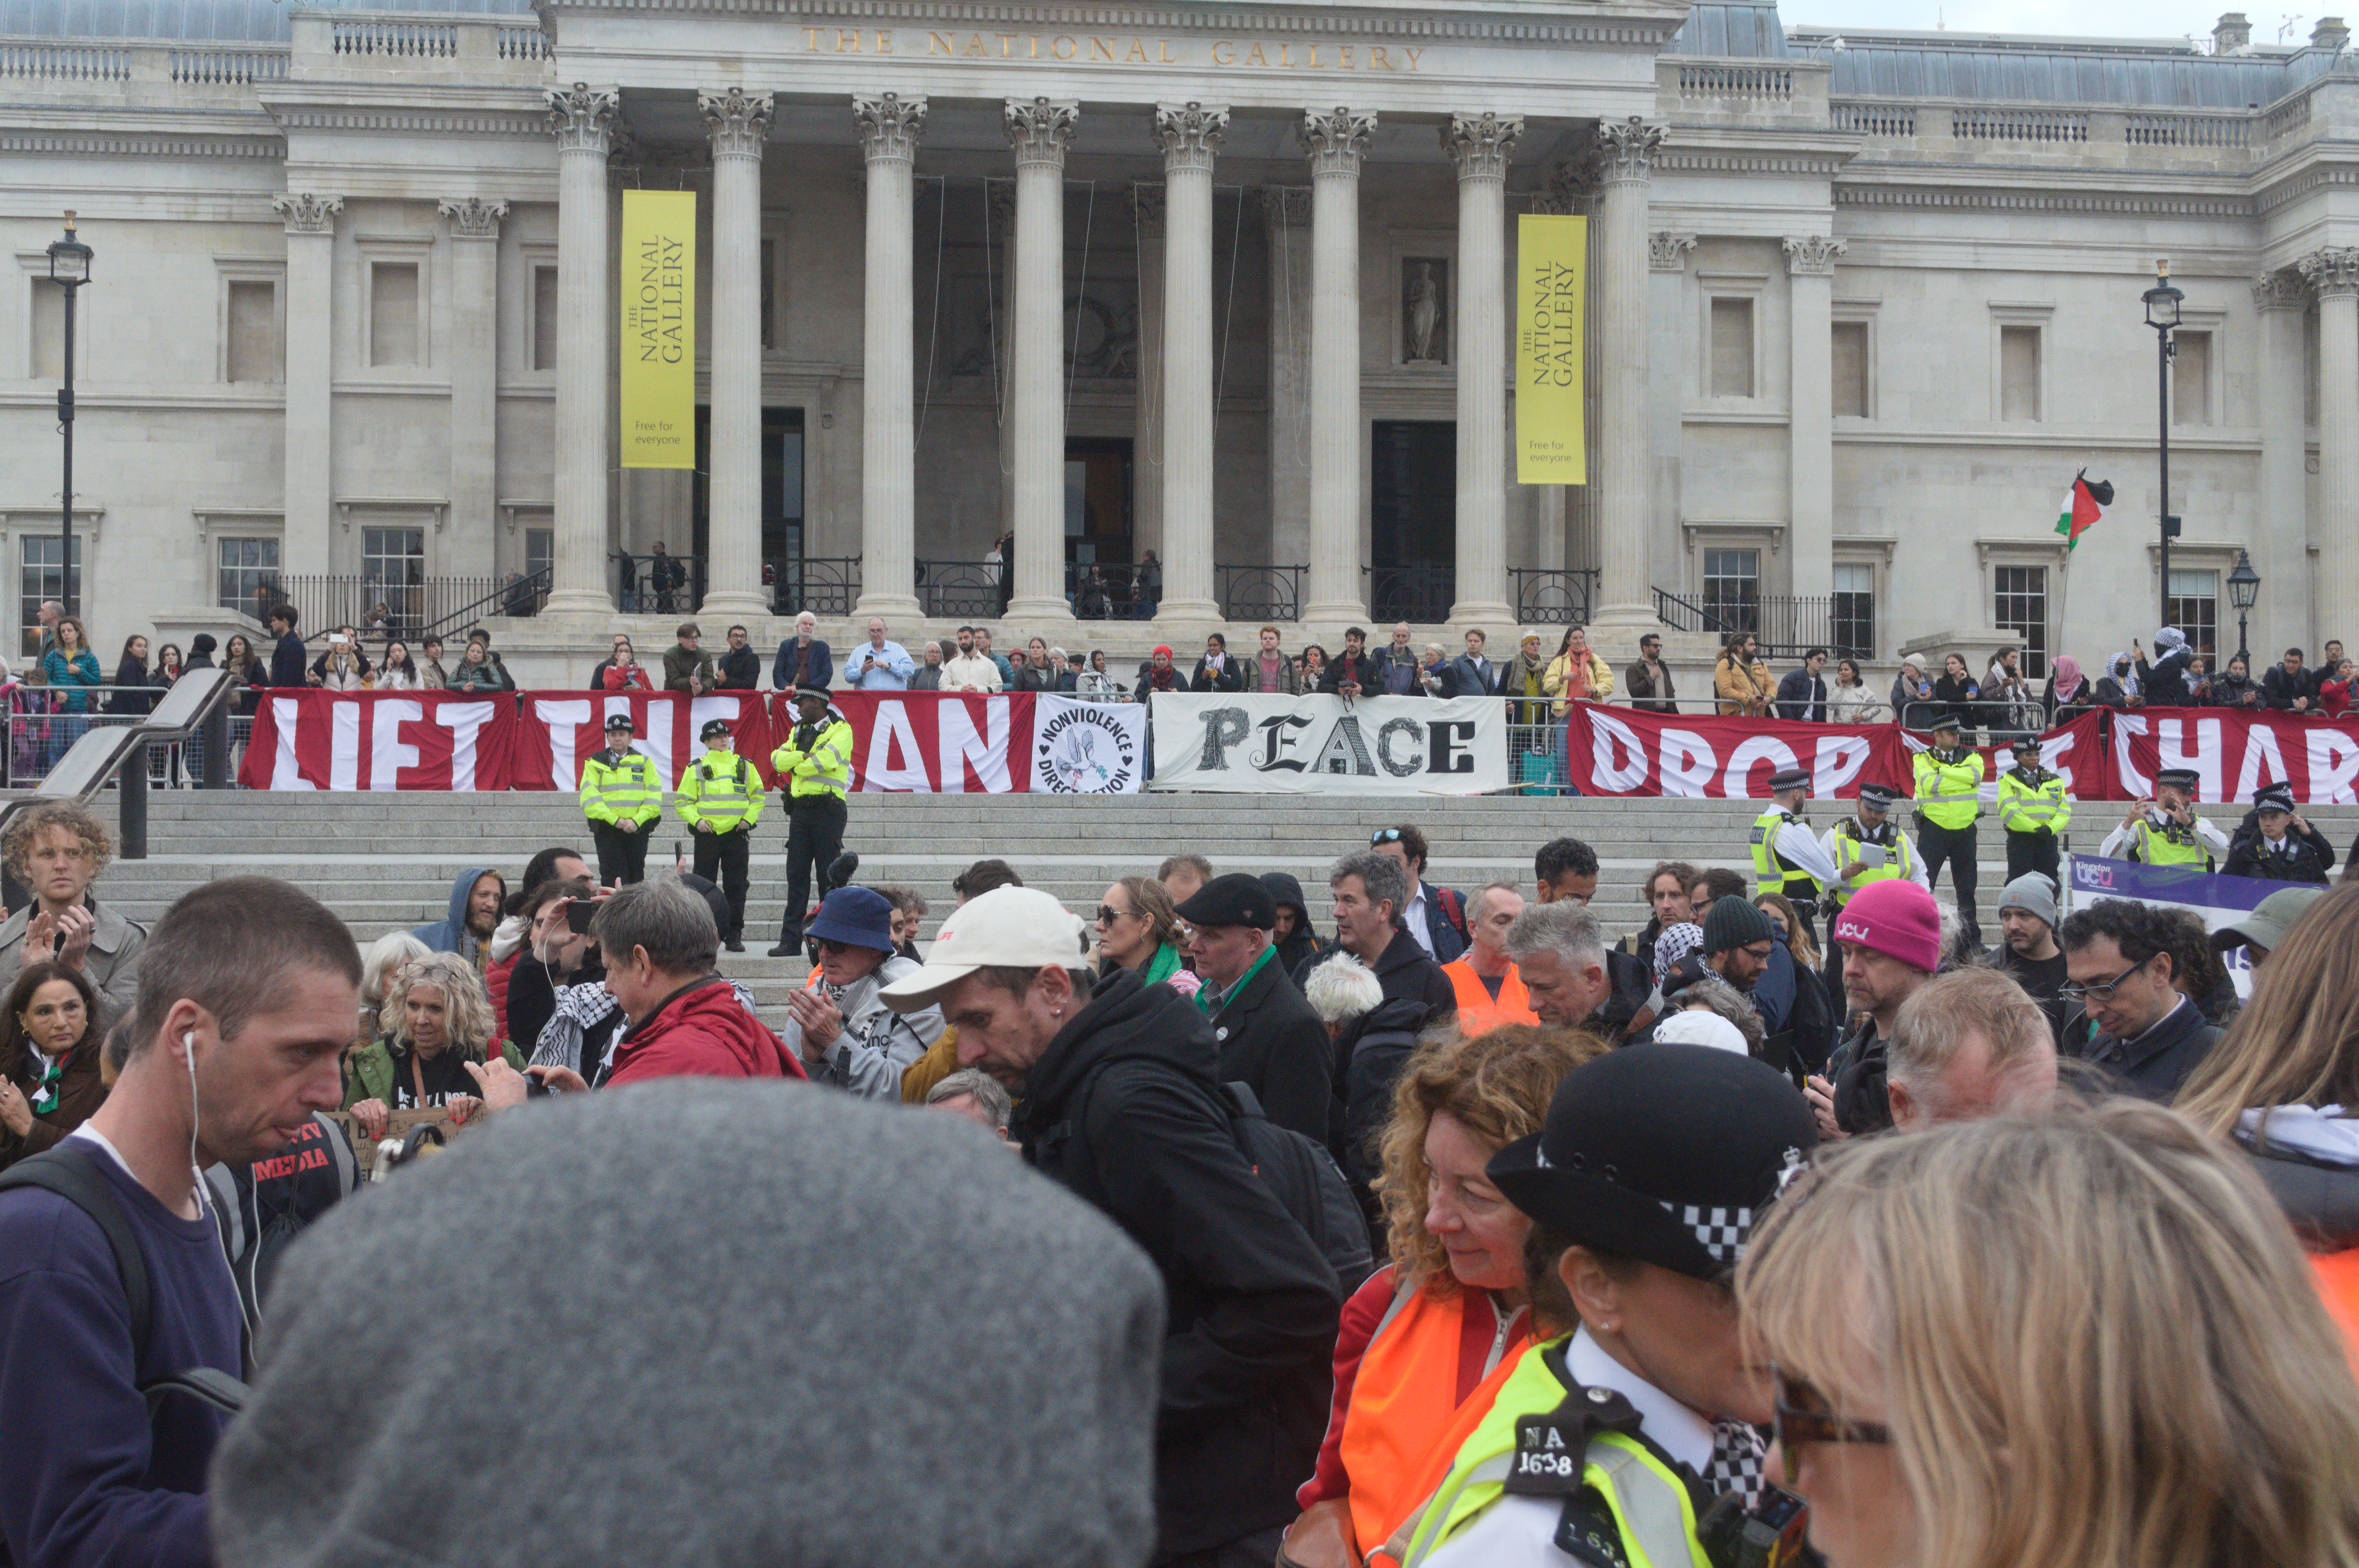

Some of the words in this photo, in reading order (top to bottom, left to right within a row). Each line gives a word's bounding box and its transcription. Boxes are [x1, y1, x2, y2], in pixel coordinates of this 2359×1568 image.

[801, 26, 894, 54] THE
[928, 31, 1176, 64] NATIONAL
[1211, 41, 1427, 71] GALLERY
[628, 304, 638, 329] THE
[640, 234, 659, 363] NATIONAL
[662, 236, 683, 364] GALLERY
[1523, 328, 1532, 353] THE
[1534, 260, 1551, 386] NATIONAL
[1553, 262, 1574, 387] GALLERY
[635, 421, 656, 431] Free
[659, 420, 673, 431] for
[635, 435, 681, 446] everyone
[1529, 440, 1549, 450] Free
[1551, 440, 1564, 450] for
[1529, 453, 1572, 464] everyone
[269, 697, 495, 791] LIFT
[785, 695, 1012, 793] AN
[1041, 708, 1133, 752] NONVIOLENCE
[1195, 706, 1476, 777] PEACE
[1586, 707, 1870, 799] DROP
[2076, 860, 2111, 873] Kingston
[253, 1147, 328, 1181] MEDIA
[1518, 1450, 1573, 1477] 1638
